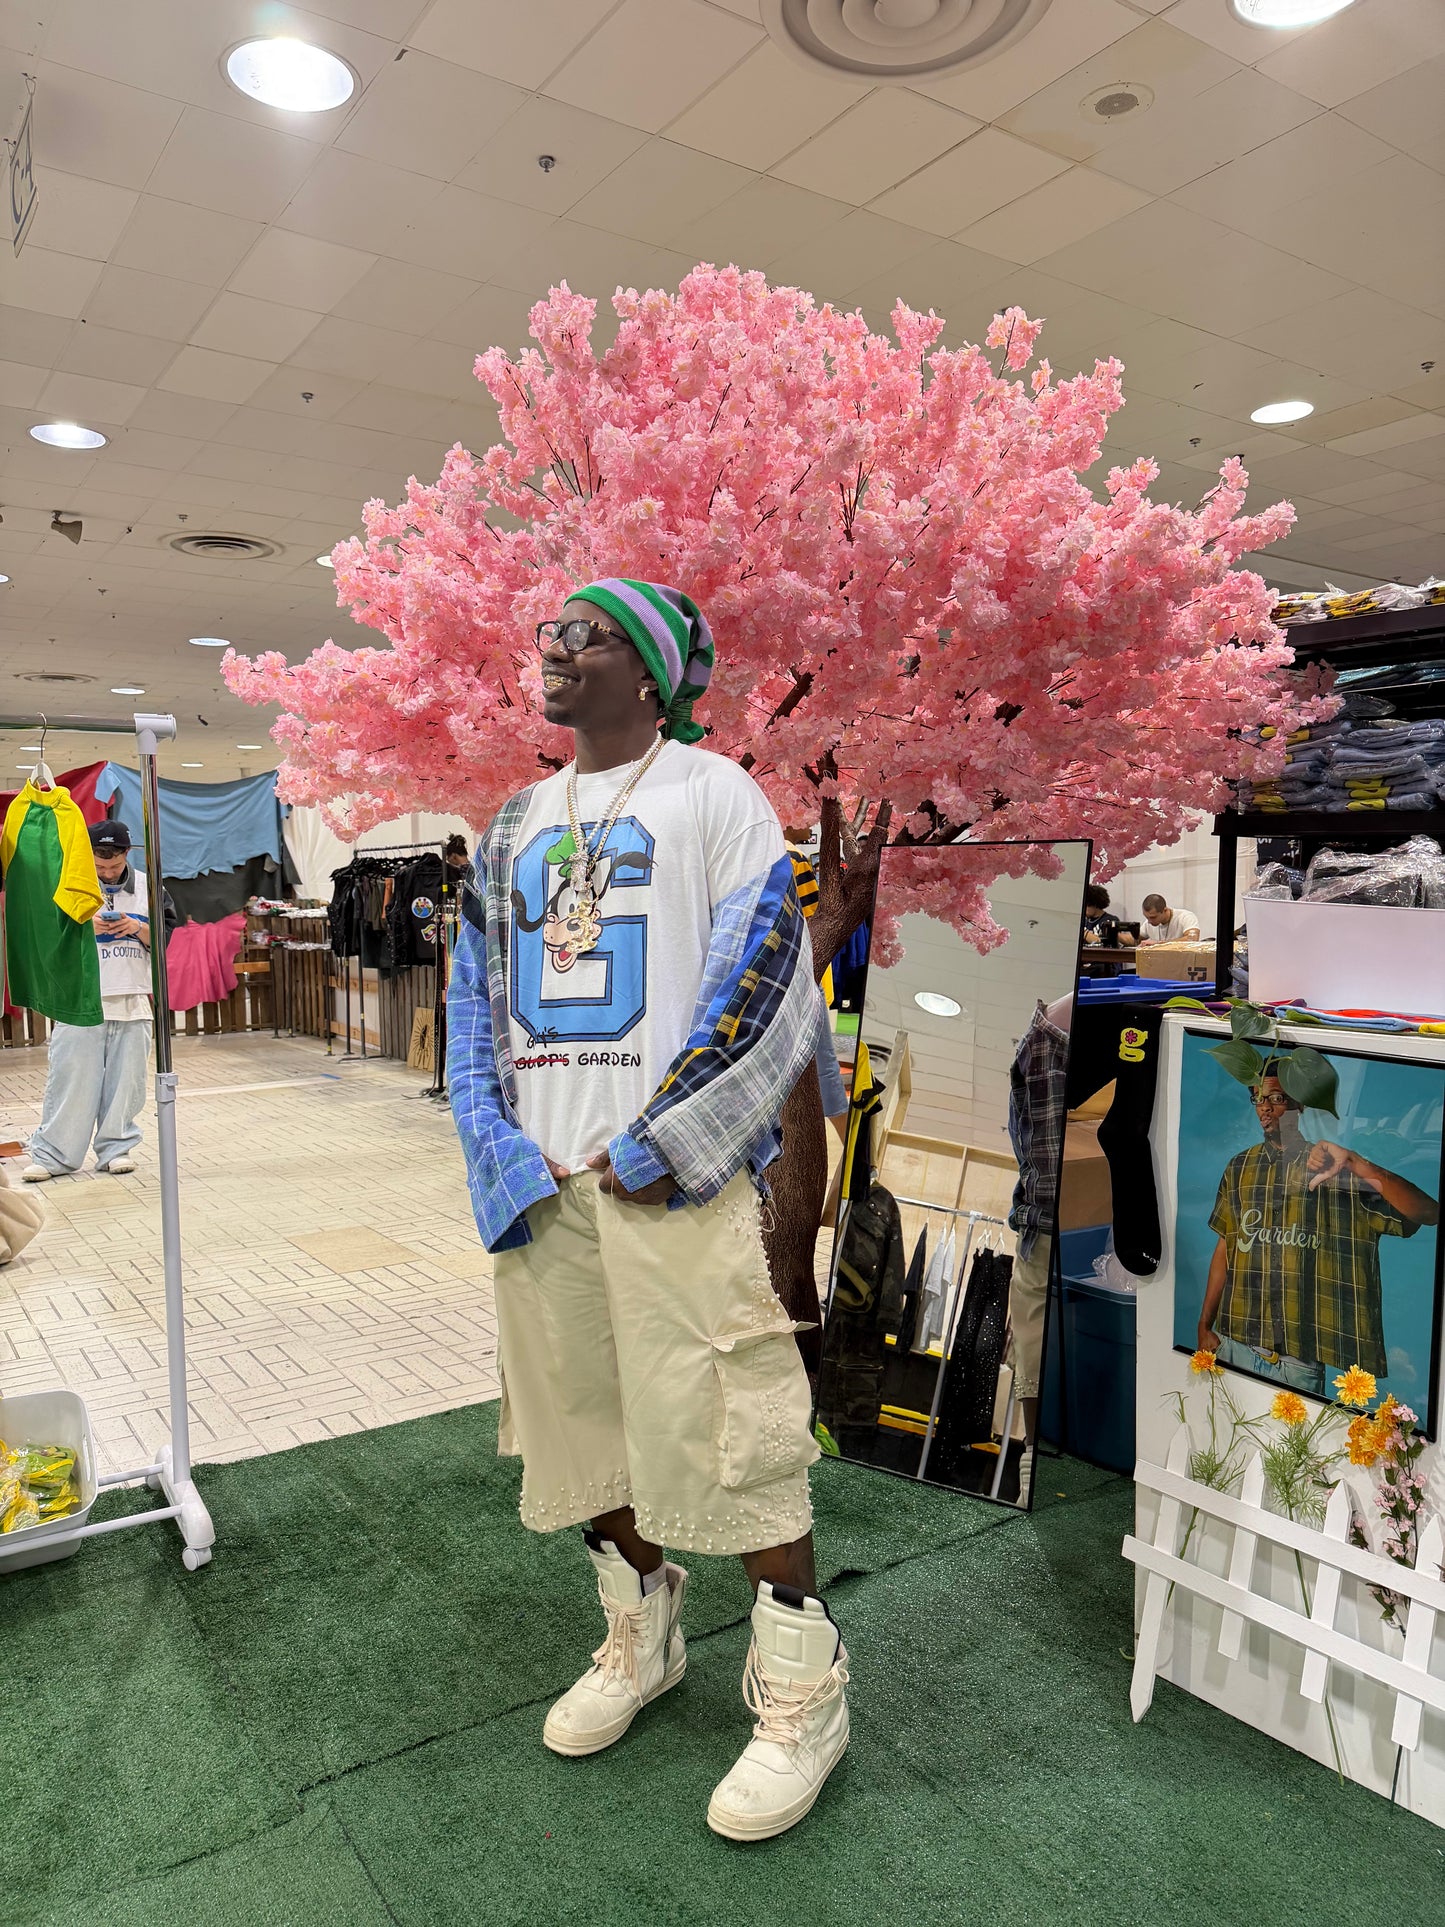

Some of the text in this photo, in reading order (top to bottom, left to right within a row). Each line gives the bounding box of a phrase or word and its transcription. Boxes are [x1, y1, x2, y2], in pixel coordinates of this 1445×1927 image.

[577, 1052, 642, 1068] GARDEN
[1118, 1027, 1149, 1063] g
[1236, 1208, 1321, 1253] Garden
